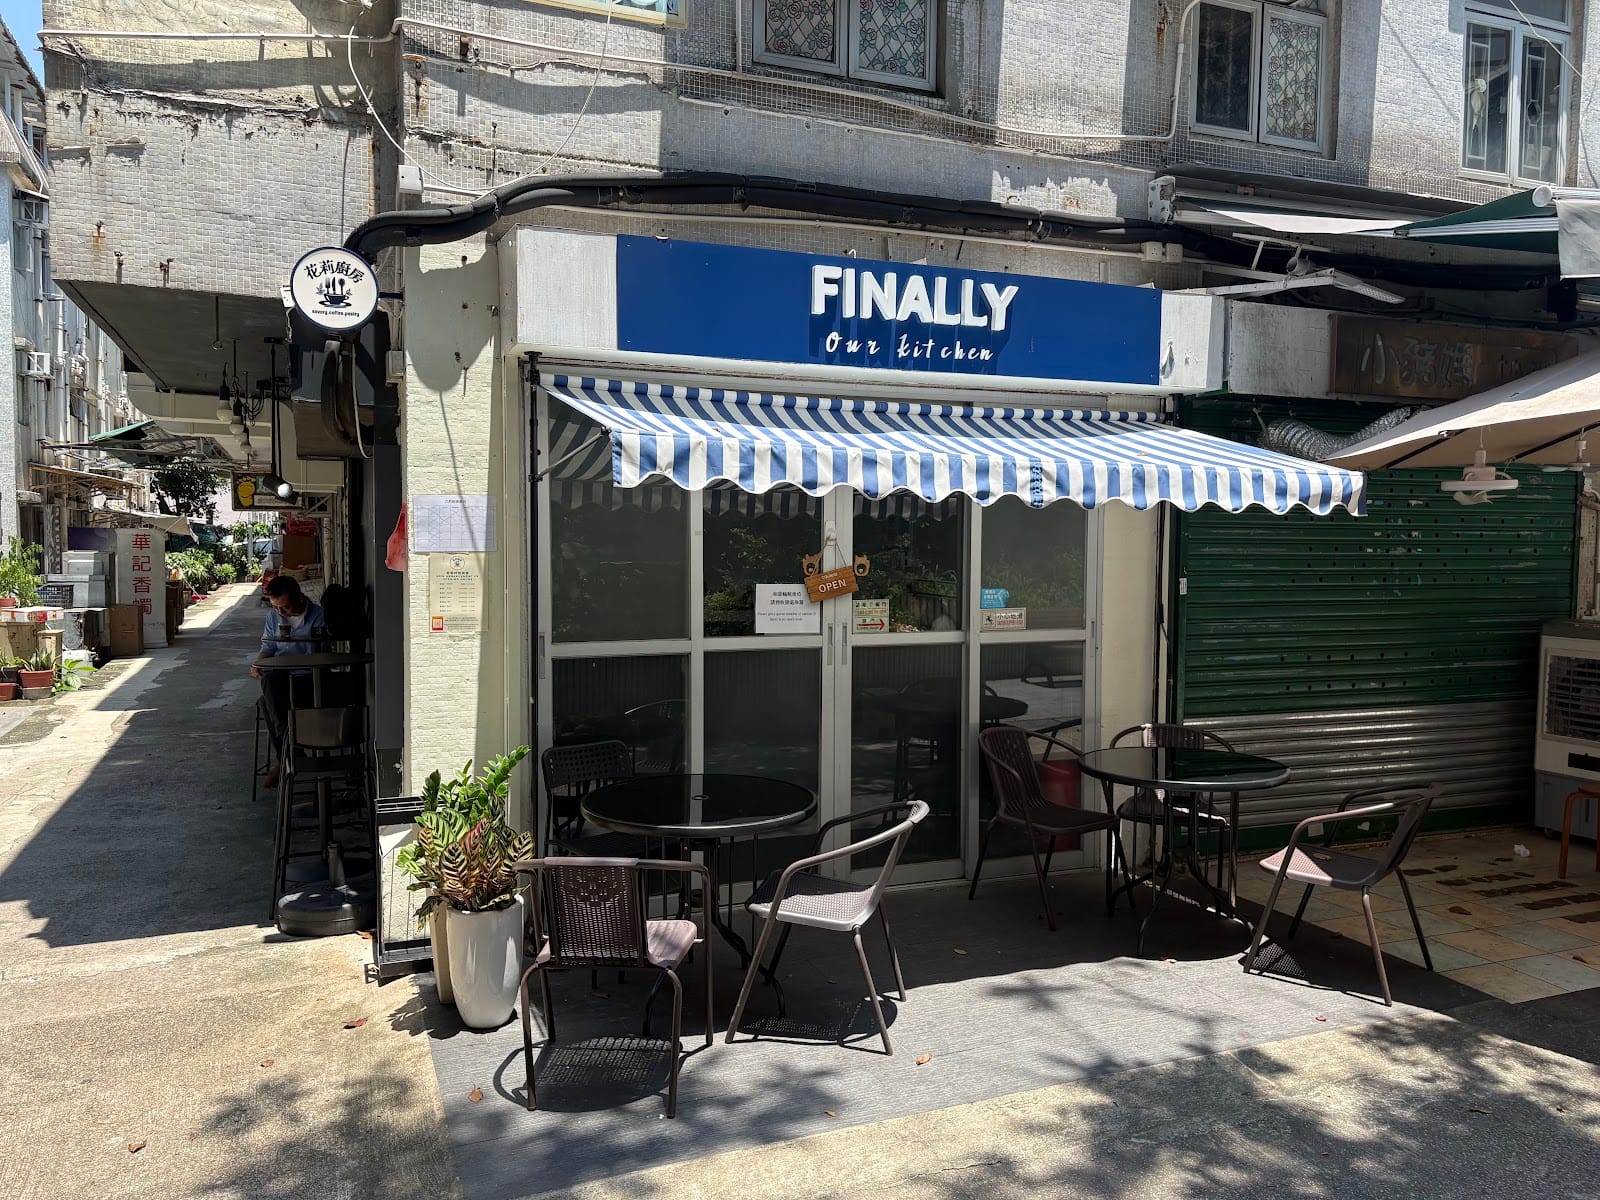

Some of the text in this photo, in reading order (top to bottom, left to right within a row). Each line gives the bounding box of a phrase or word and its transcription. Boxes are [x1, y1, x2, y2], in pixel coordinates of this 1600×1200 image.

[304, 260, 365, 284] 花莉廚房
[811, 264, 1019, 331] FINALLY
[825, 331, 994, 361] Our kitchen
[818, 578, 846, 593] OPEN
